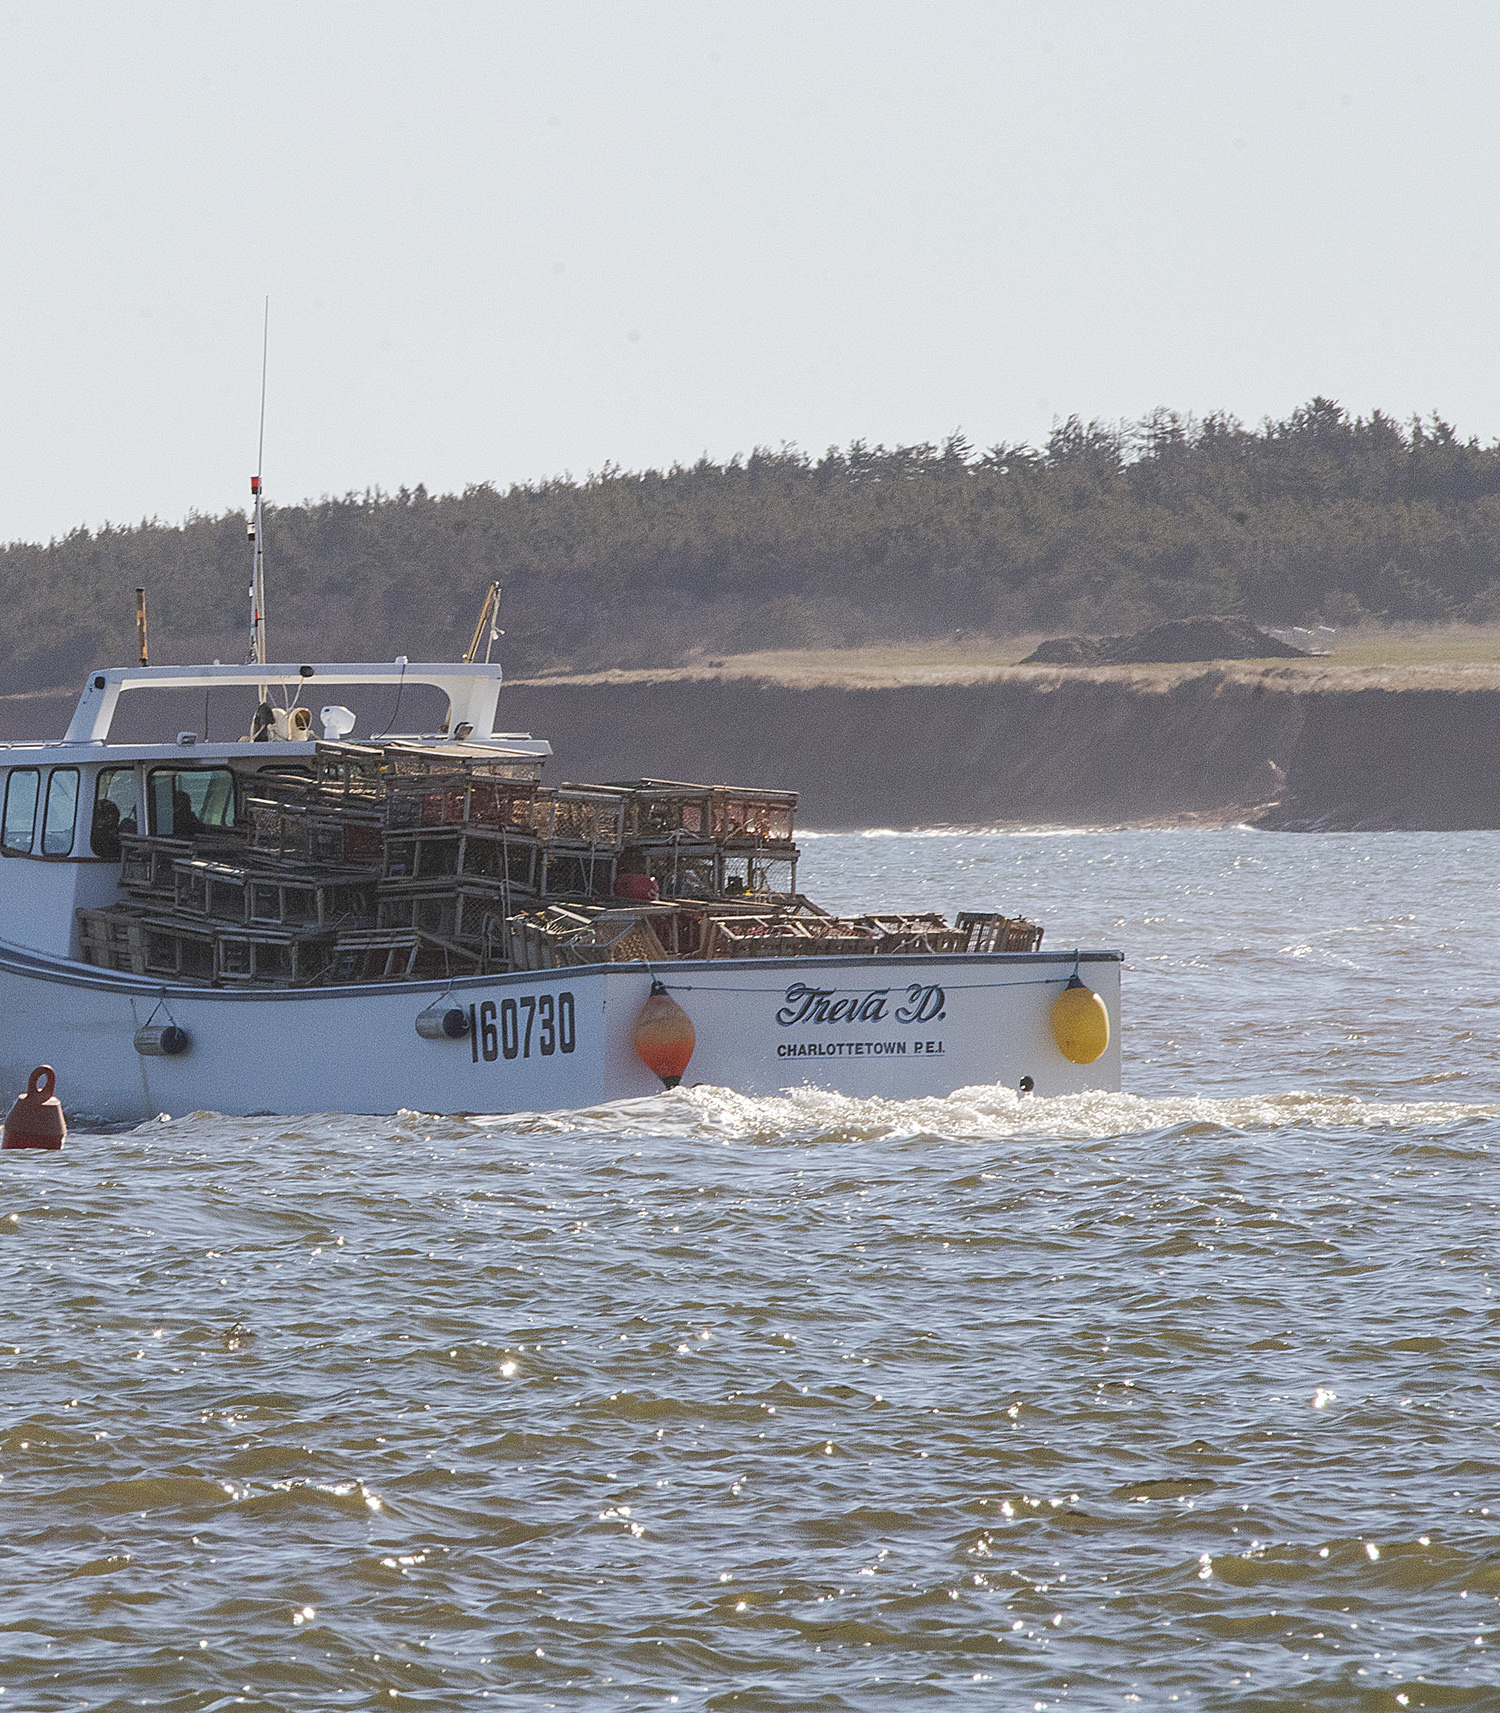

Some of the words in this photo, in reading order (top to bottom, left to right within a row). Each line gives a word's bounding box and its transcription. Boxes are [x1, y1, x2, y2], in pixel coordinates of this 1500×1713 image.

[469, 991, 576, 1063] 160730
[775, 982, 891, 1027] Treva
[895, 983, 946, 1024] D.
[777, 1041, 906, 1057] CHARLOTTETOWN
